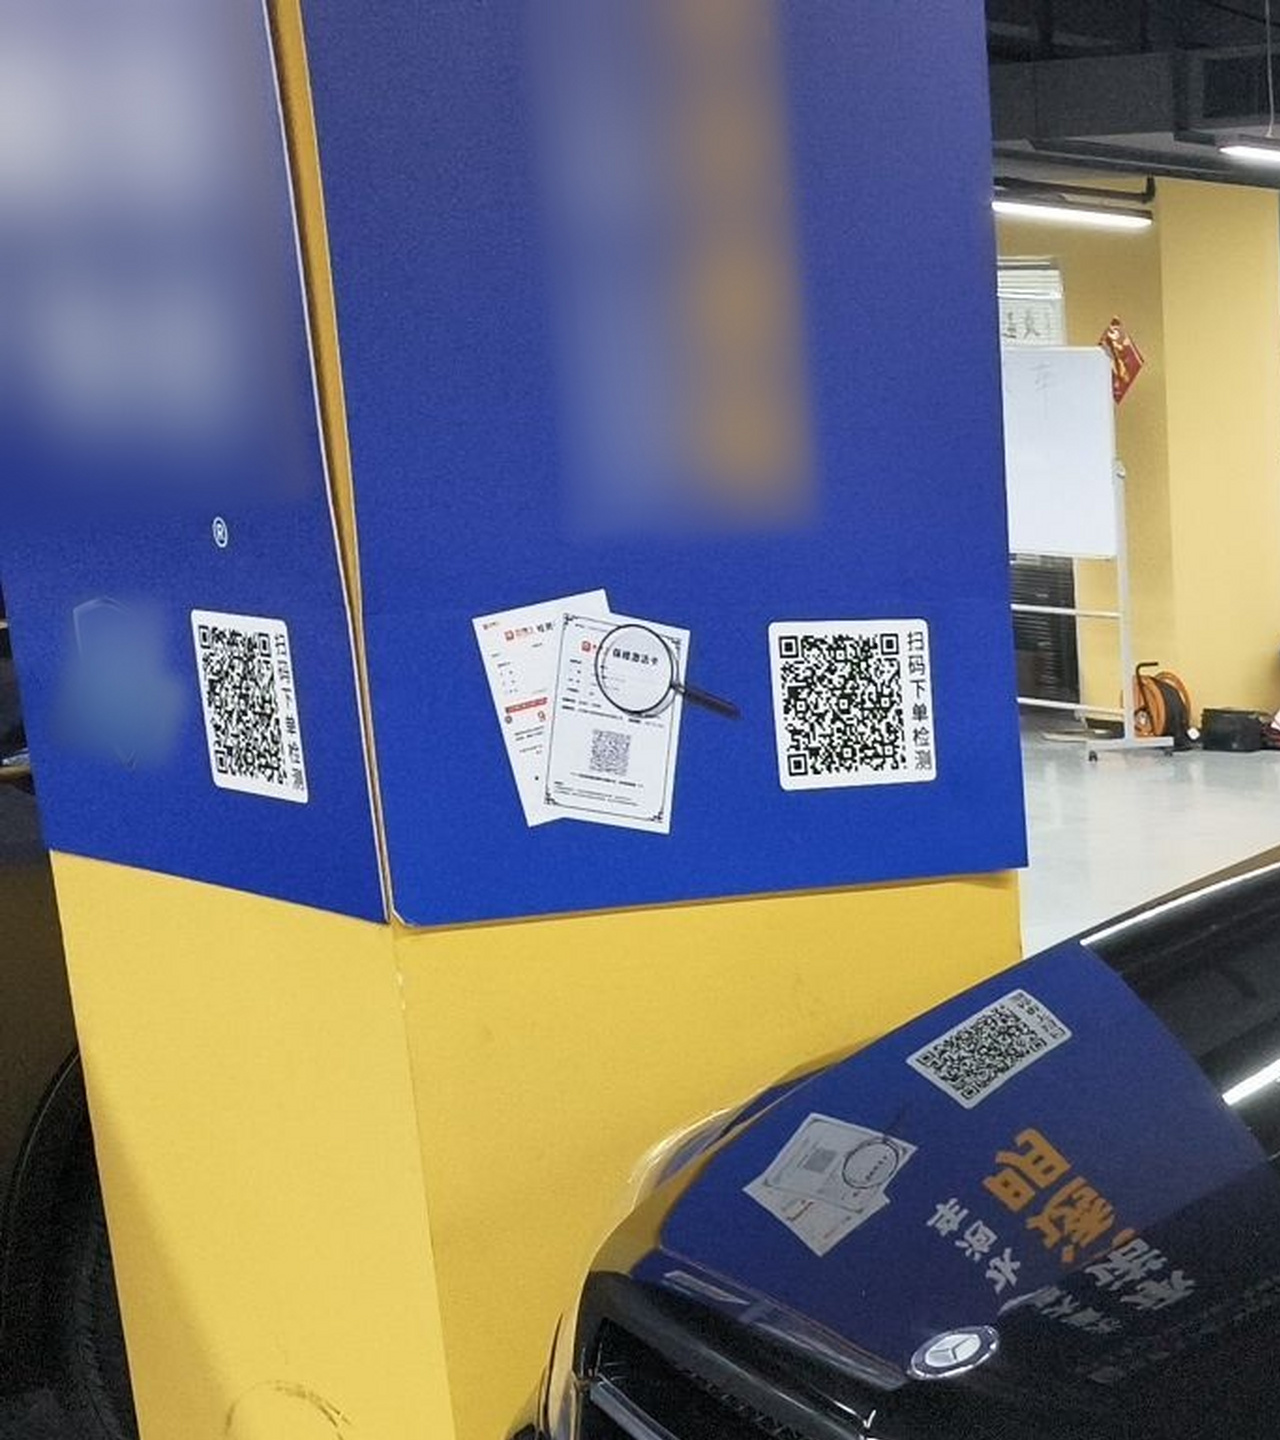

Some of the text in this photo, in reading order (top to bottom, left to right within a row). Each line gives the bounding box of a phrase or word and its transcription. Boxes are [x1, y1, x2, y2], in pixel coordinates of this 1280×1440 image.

[907, 631, 932, 771] 扫码下单检测
